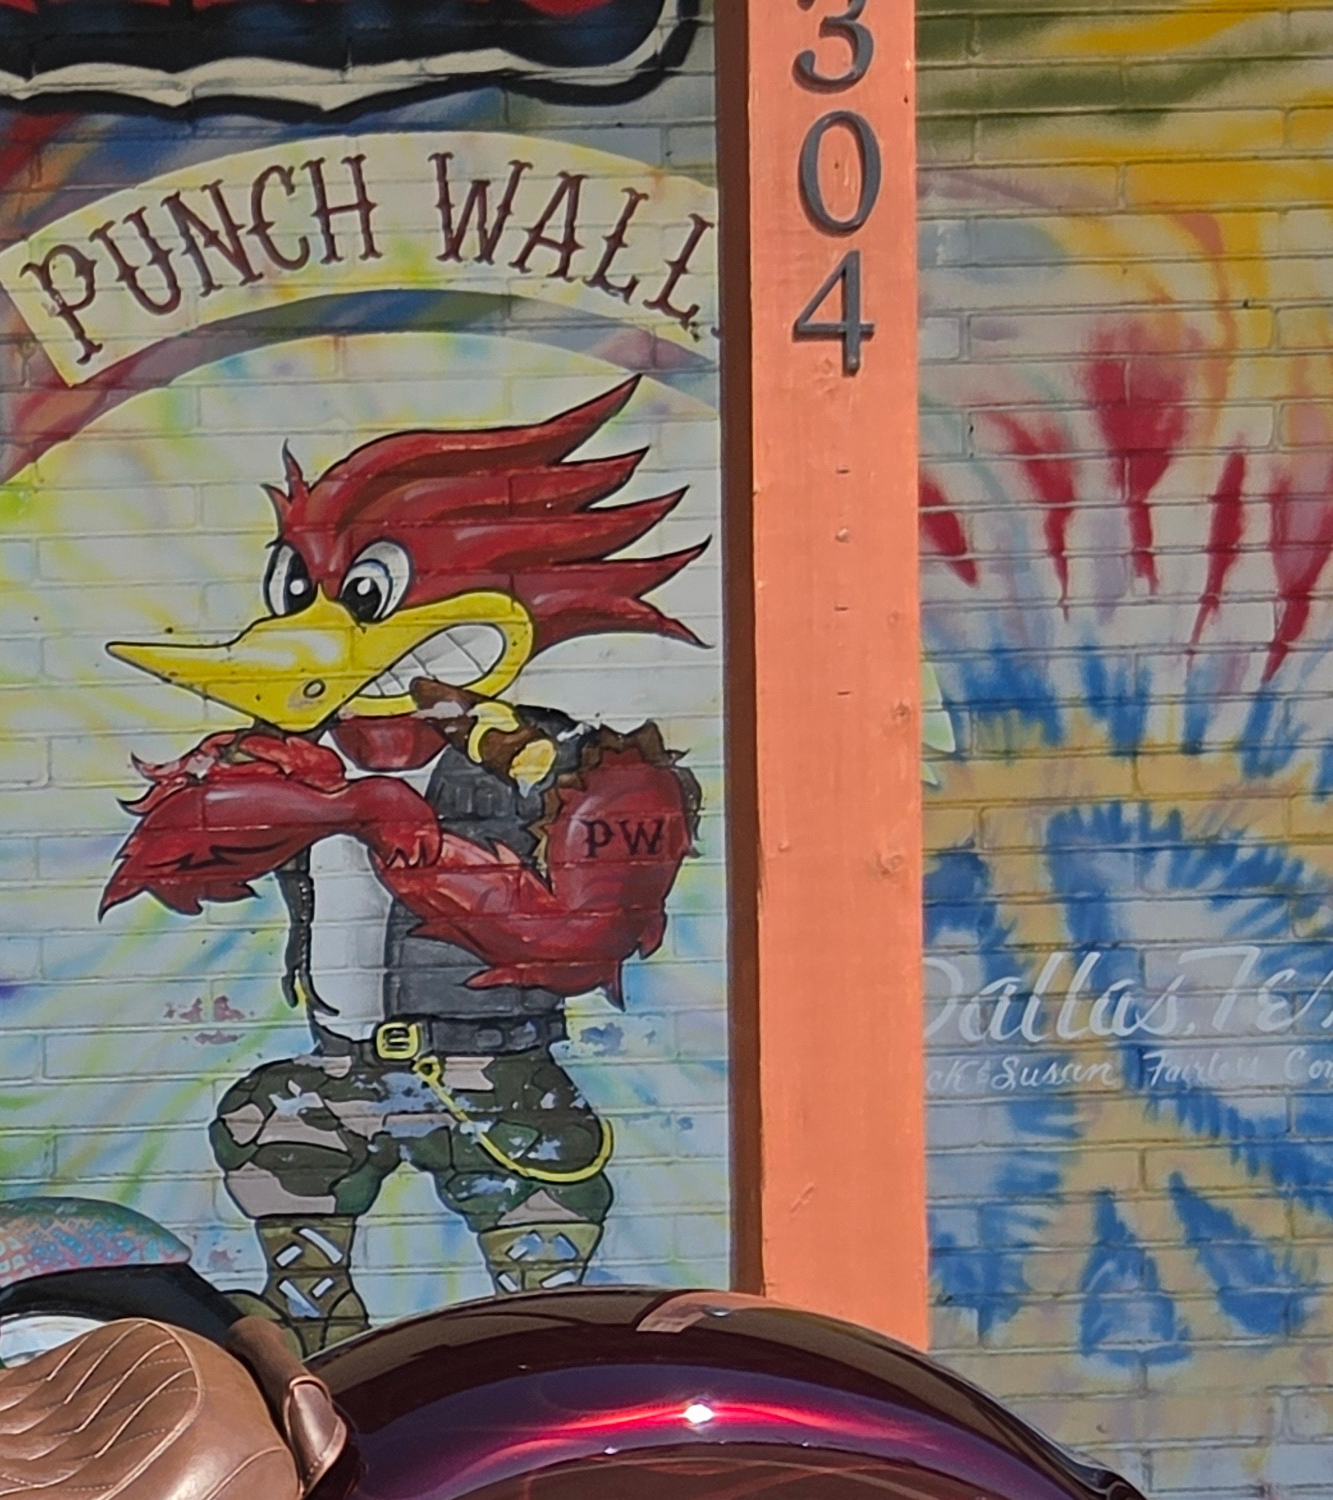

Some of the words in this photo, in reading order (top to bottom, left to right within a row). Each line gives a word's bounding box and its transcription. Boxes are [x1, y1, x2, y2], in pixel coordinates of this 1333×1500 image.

[792, 0, 882, 378] 304
[20, 154, 385, 366] PUNCH
[426, 151, 717, 330] WALL
[580, 818, 666, 859] PW
[990, 1055, 1123, 1092] Susan
